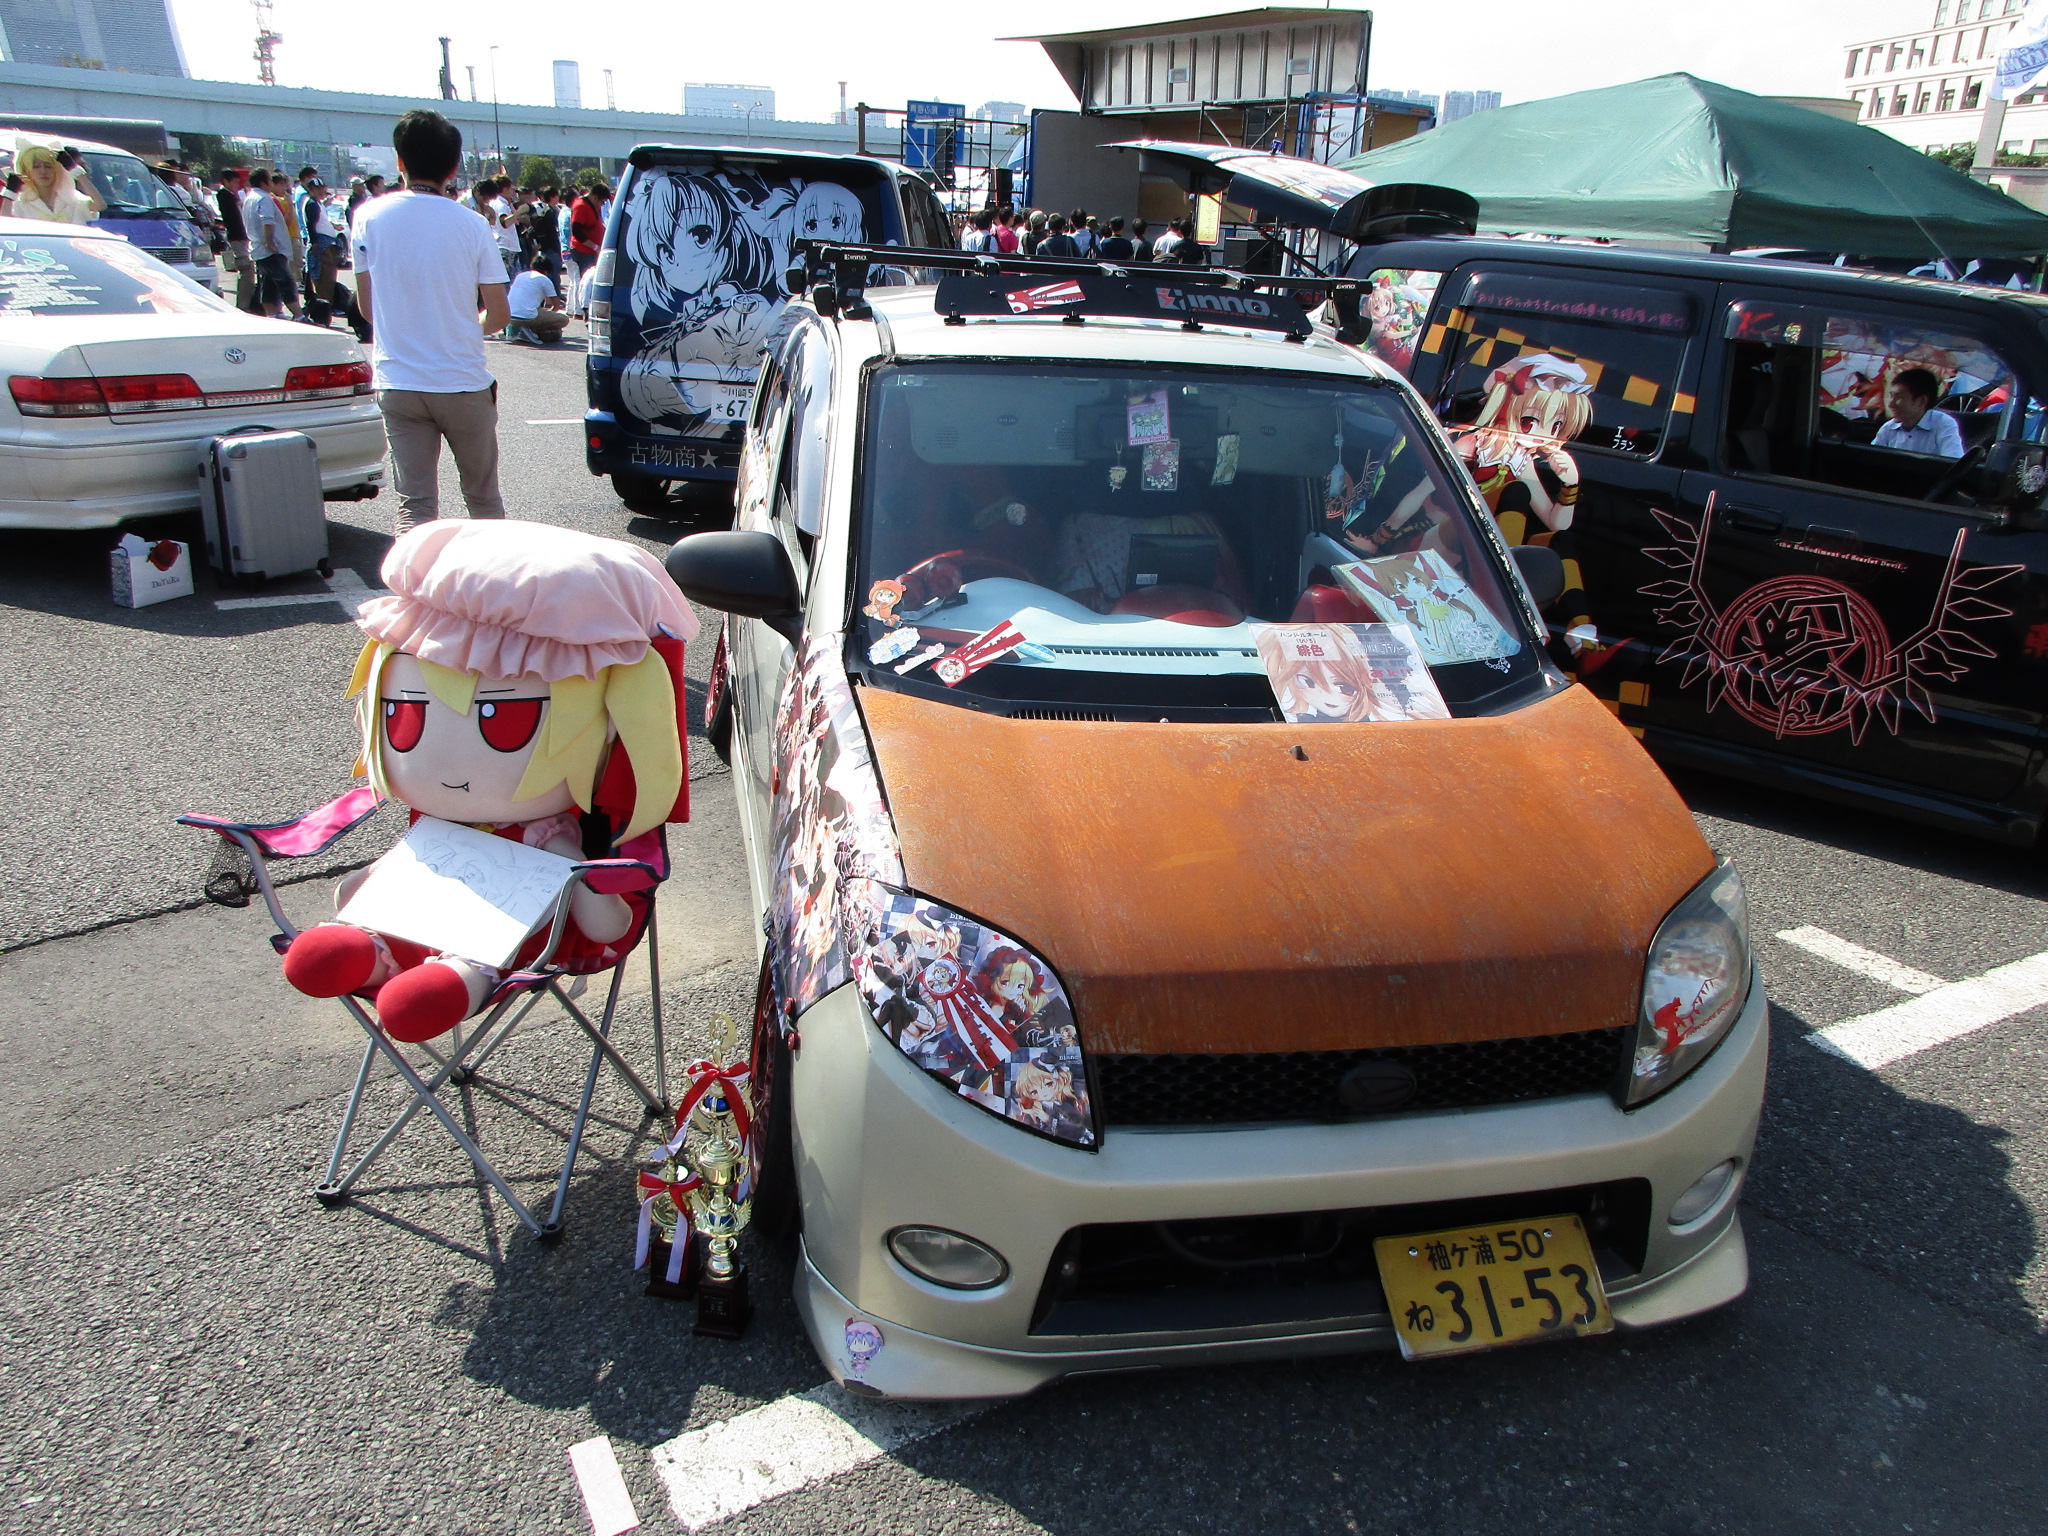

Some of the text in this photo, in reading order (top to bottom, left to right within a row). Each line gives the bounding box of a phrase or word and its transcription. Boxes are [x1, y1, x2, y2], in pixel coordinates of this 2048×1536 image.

[1612, 438, 1635, 451] フラン
[1497, 1228, 1545, 1262] 50
[1405, 1263, 1597, 1343] ね 31-53
